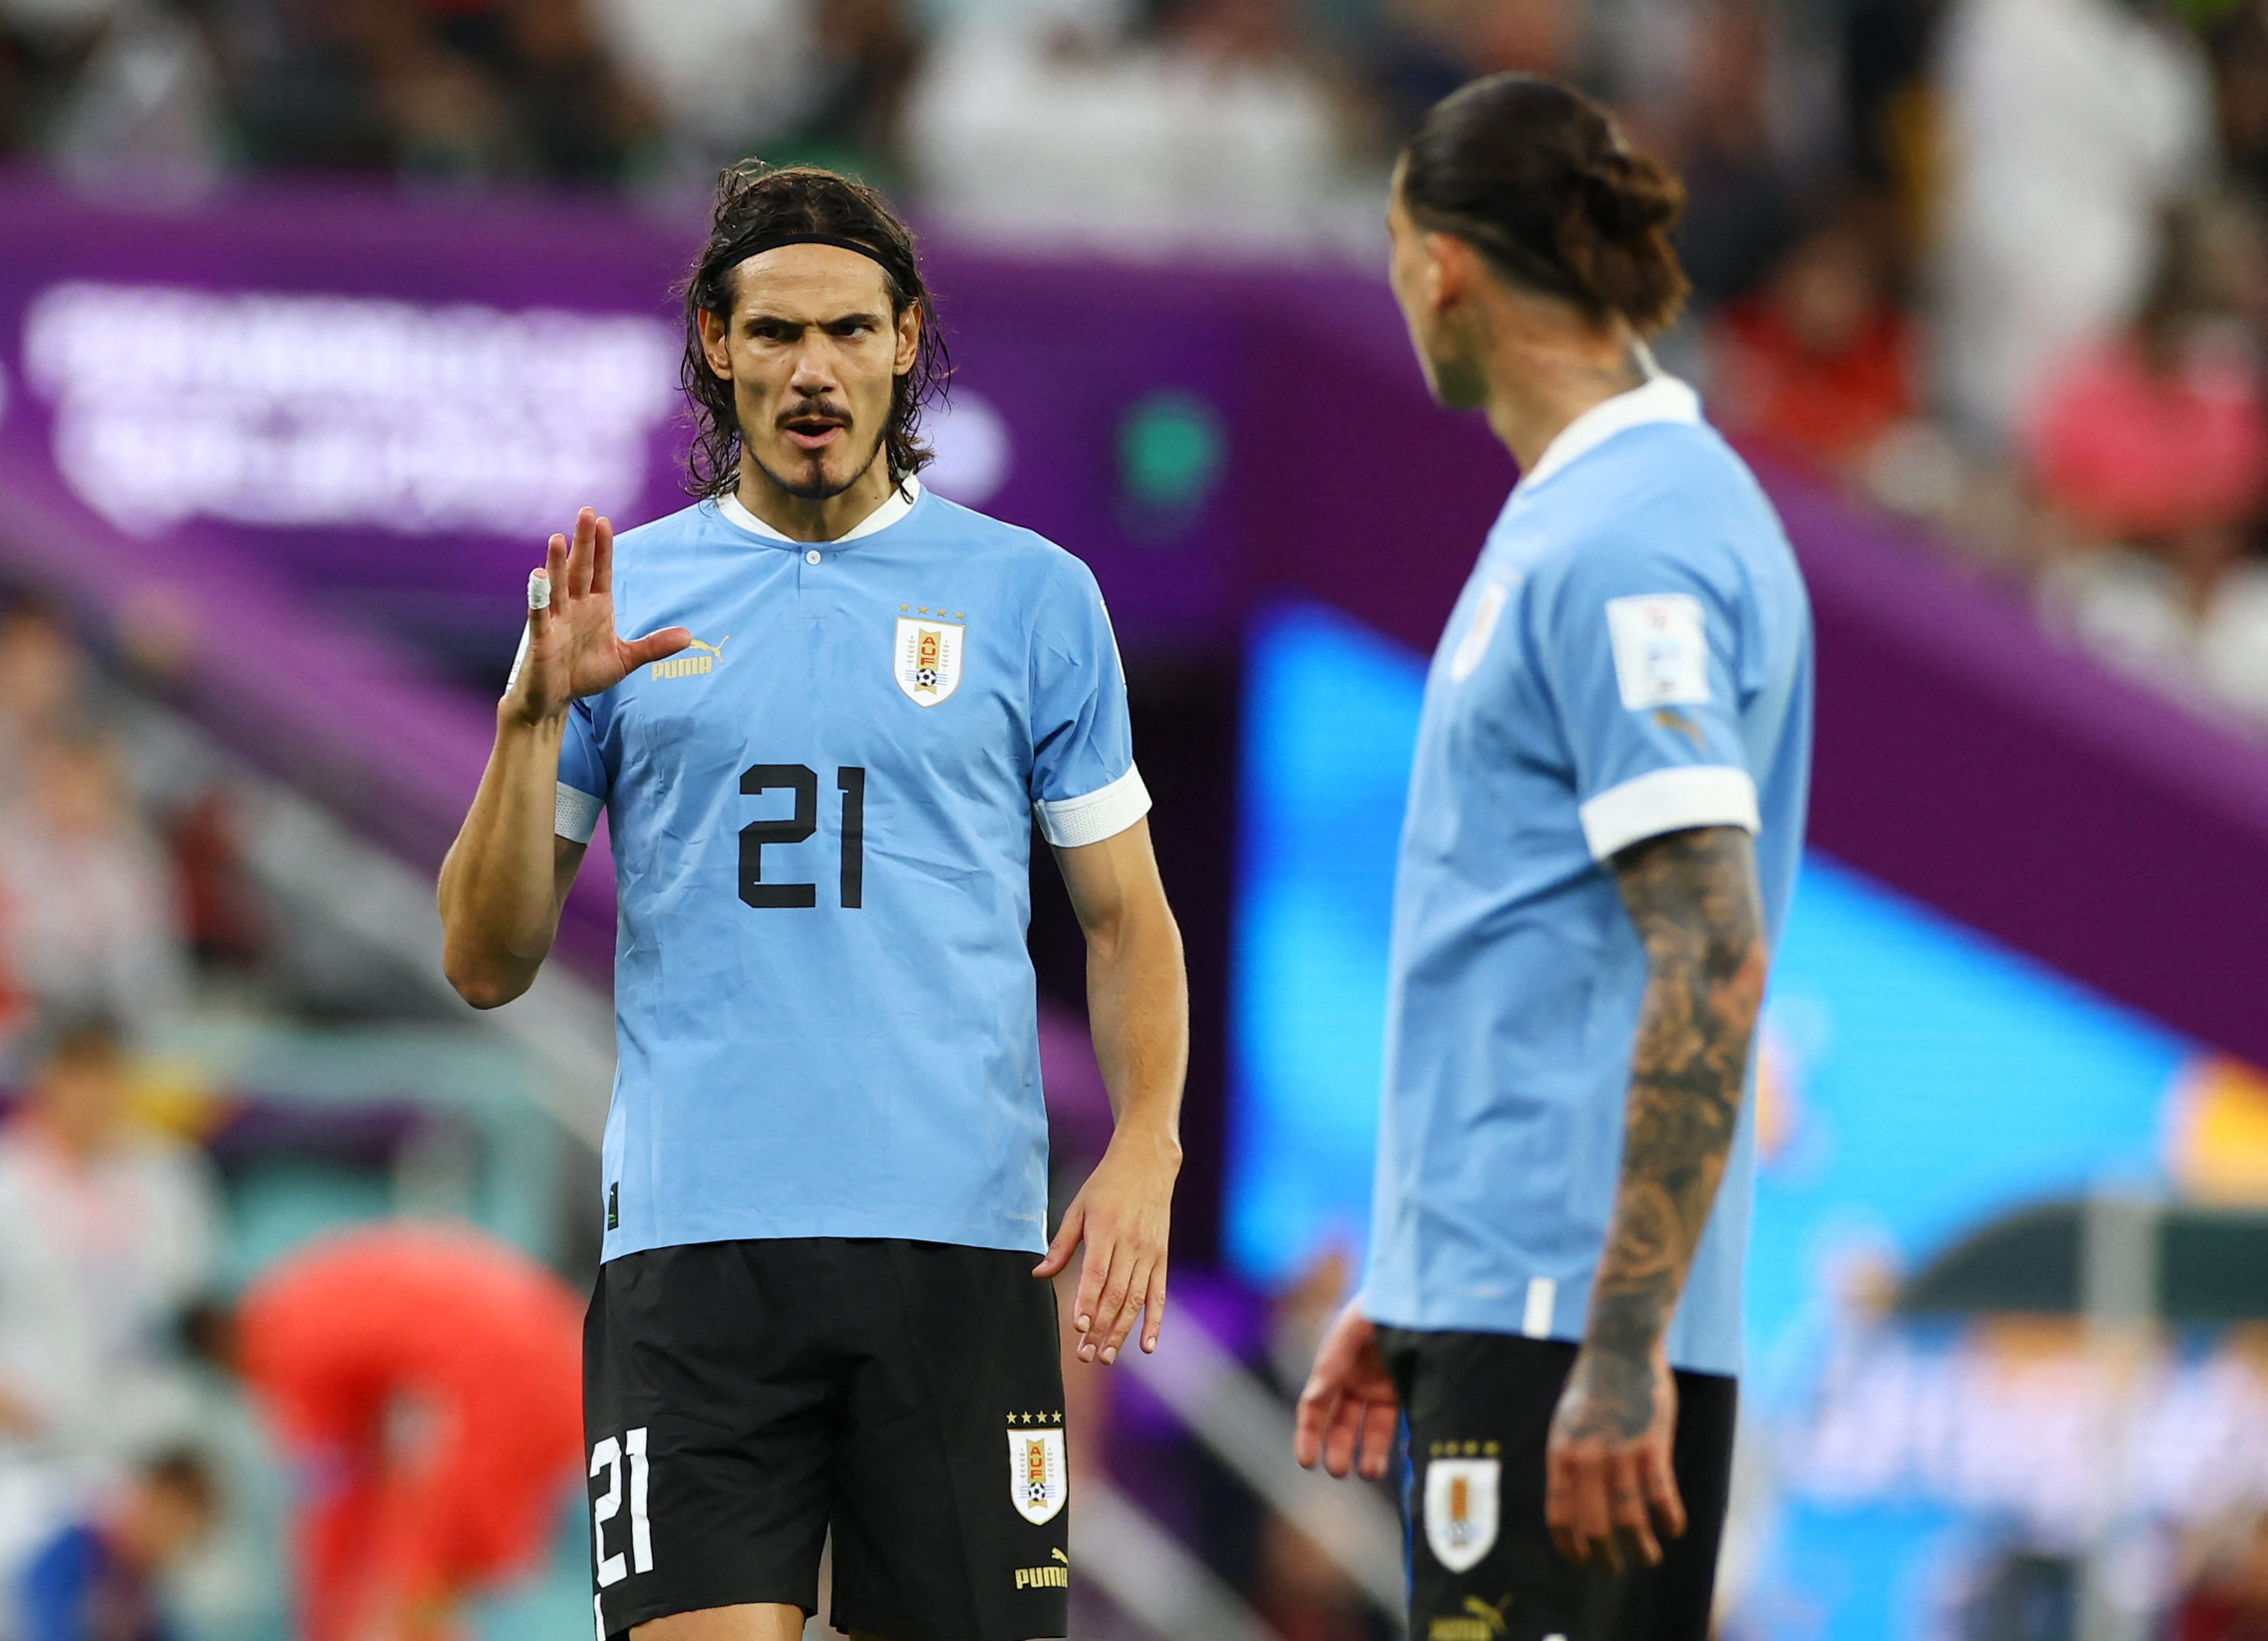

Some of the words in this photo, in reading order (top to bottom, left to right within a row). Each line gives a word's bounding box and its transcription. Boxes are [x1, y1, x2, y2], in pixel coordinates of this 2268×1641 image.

[920, 636, 935, 665] AUF
[652, 656, 712, 681] PUMA
[739, 766, 865, 908] 21
[1030, 1447, 1042, 1479] AUF
[589, 1427, 654, 1588] 21
[1015, 1566, 1068, 1589] PUMA
